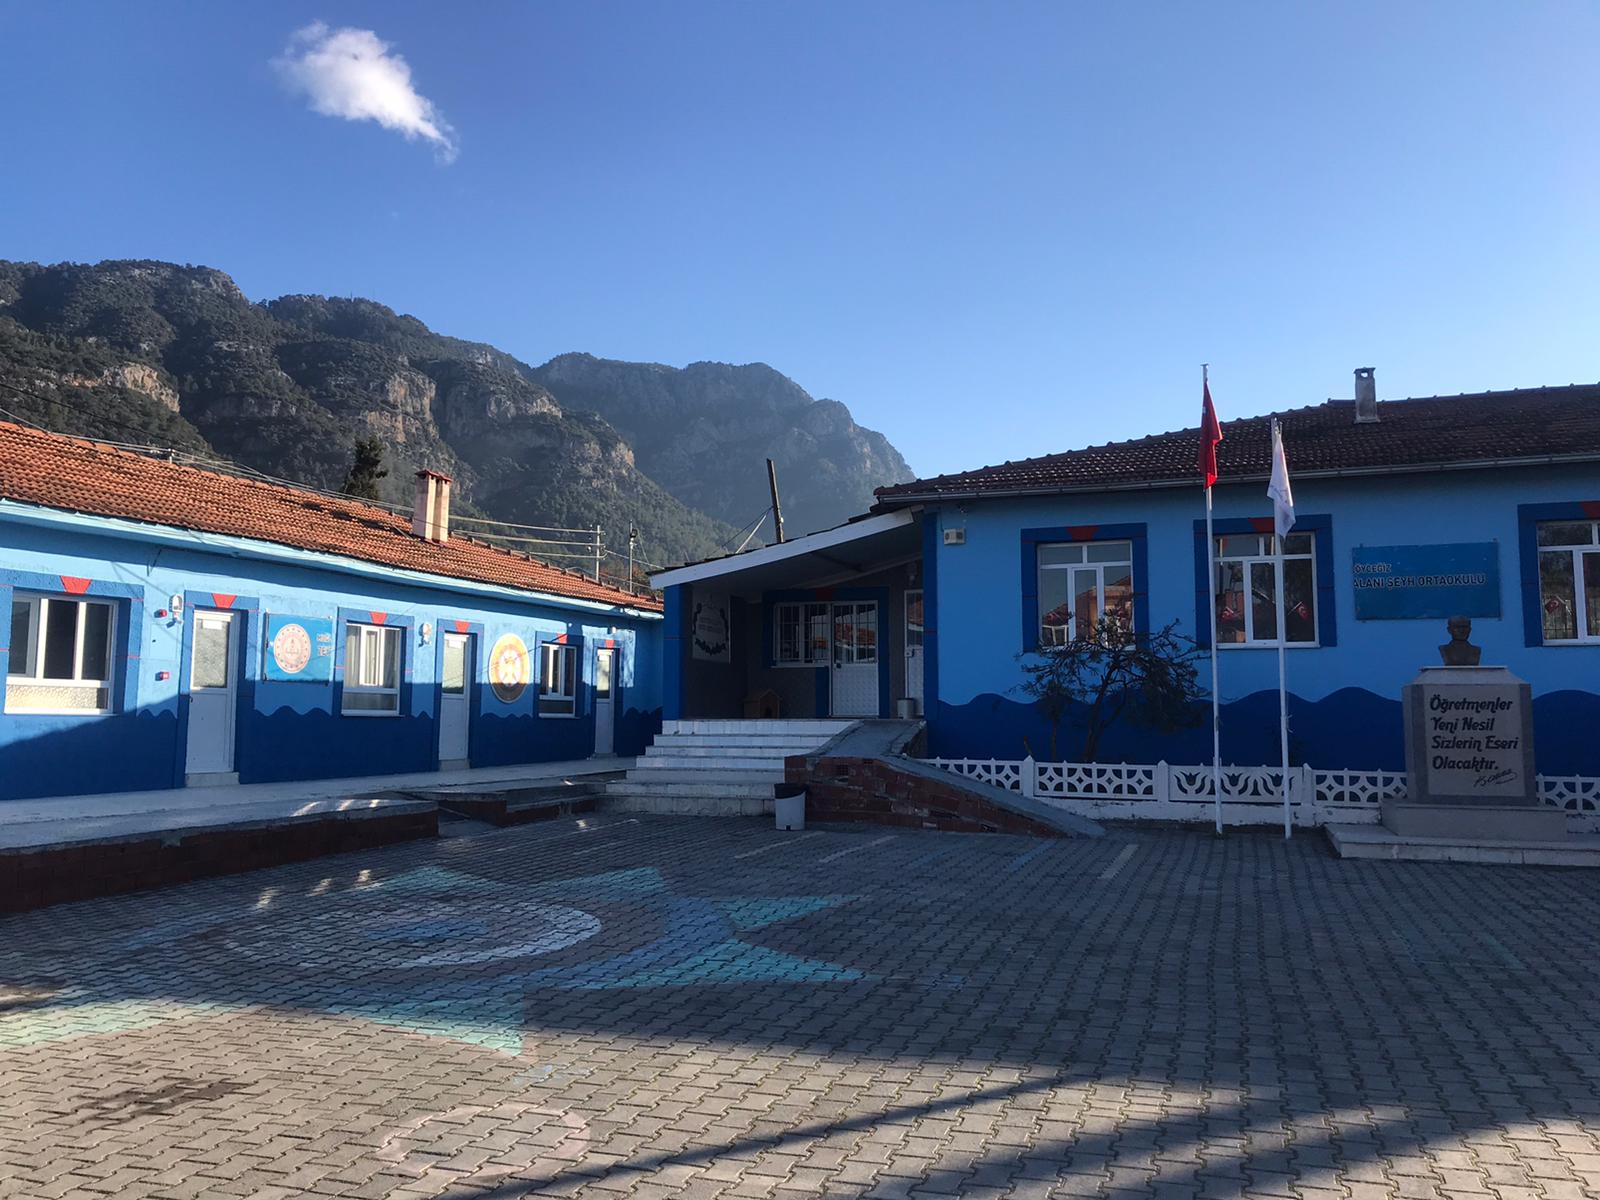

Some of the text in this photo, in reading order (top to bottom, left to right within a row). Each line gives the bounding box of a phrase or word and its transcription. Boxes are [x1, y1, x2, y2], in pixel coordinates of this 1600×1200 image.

[1387, 575, 1415, 591] ŞEYH
[1417, 573, 1487, 587] ORTAOKULU
[1430, 694, 1513, 714] Öğretmenler
[1431, 717, 1495, 734] Yeni Nesil
[1432, 736, 1519, 752] Sizlerin Eseri
[1432, 755, 1499, 773] Olacaktır.
